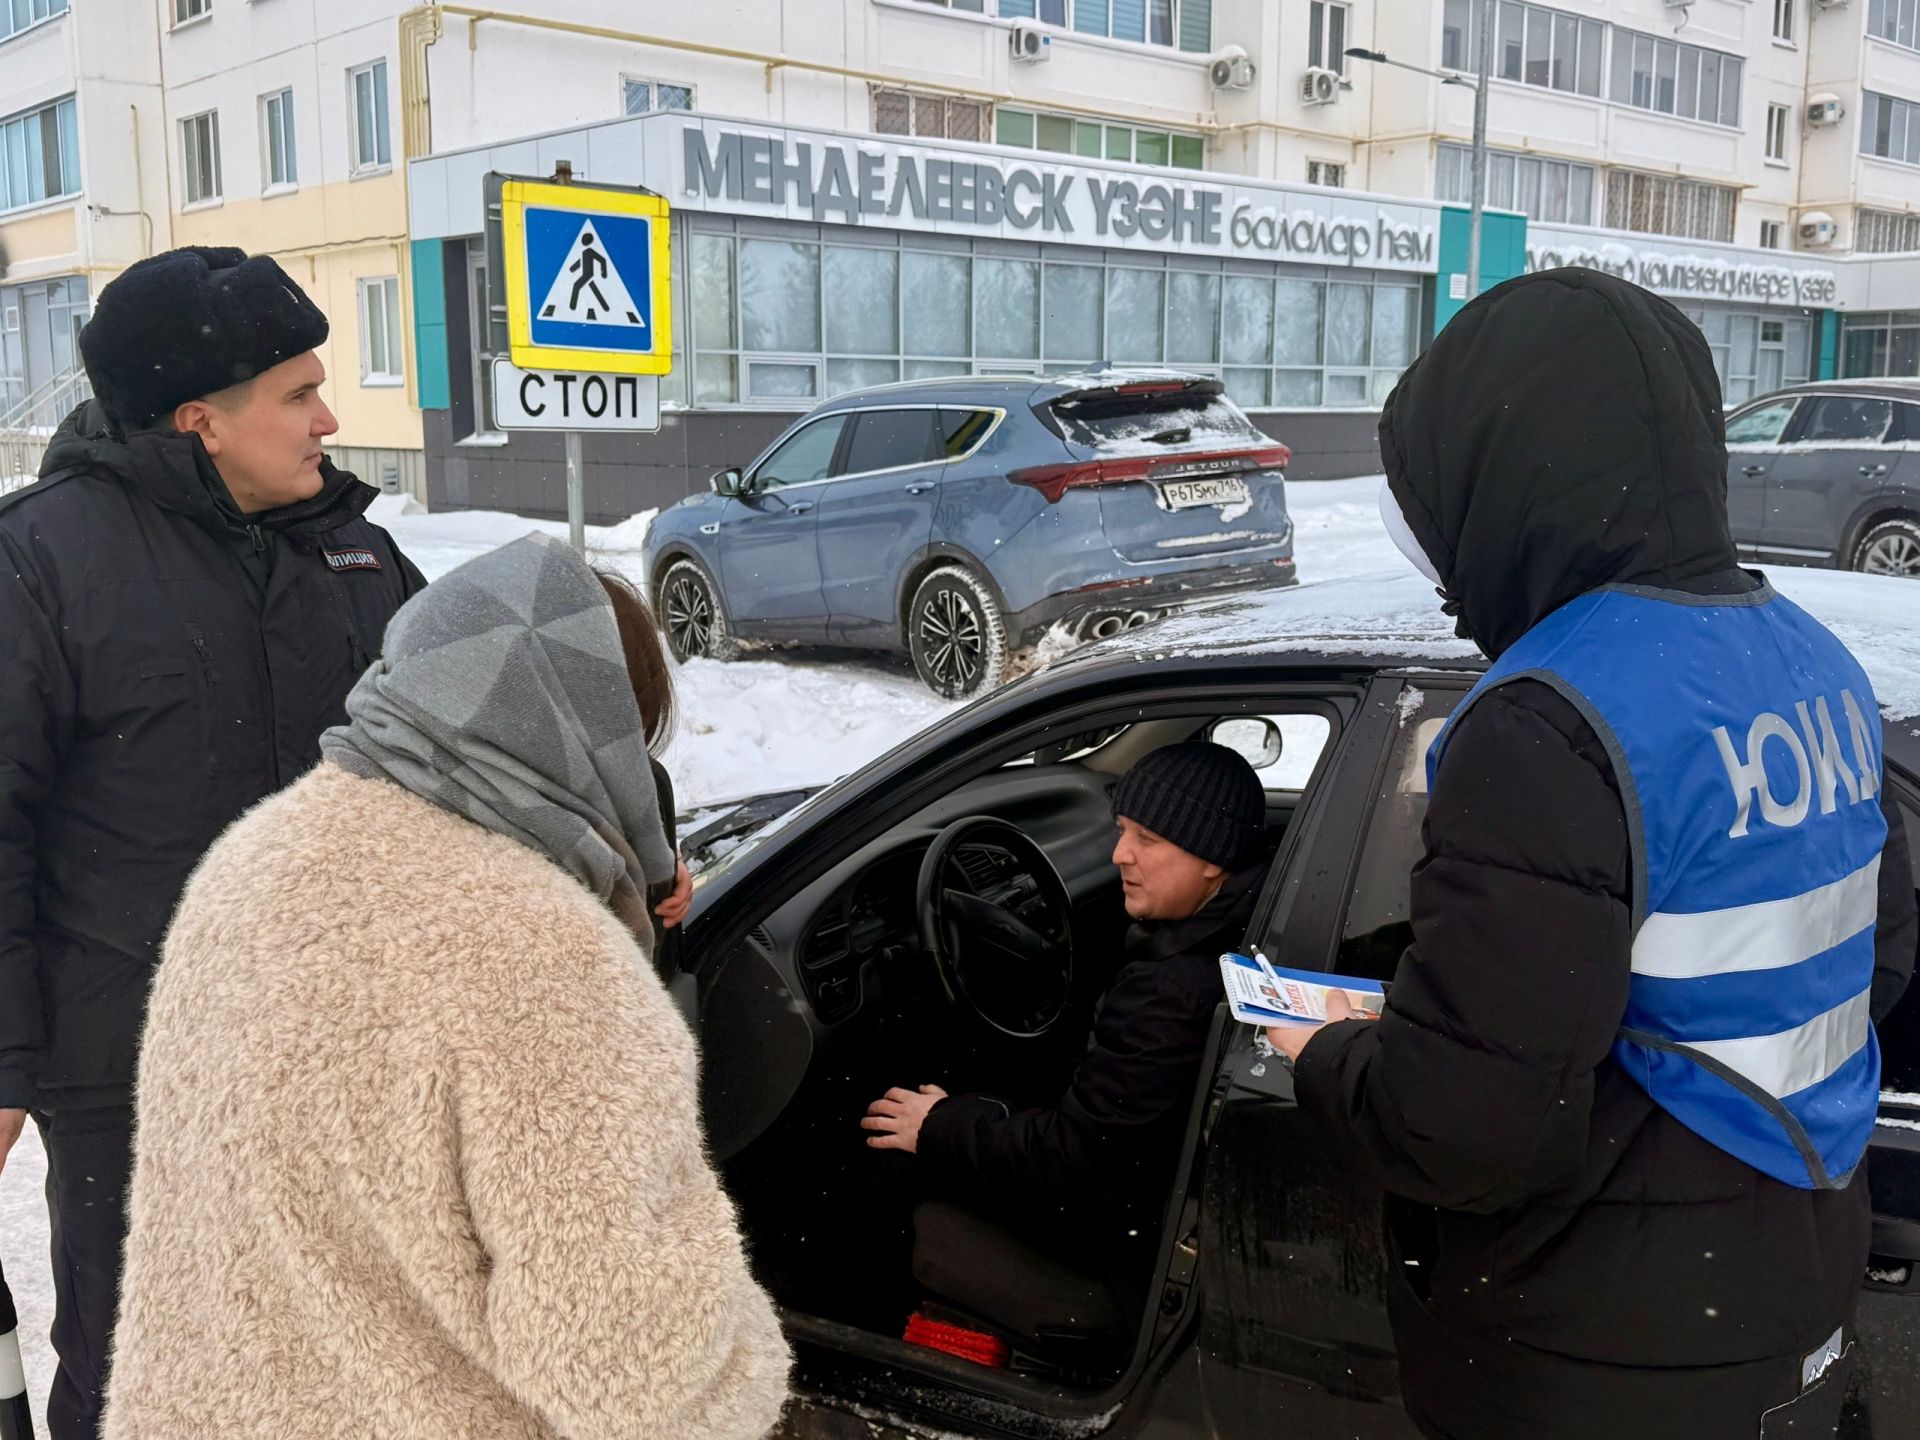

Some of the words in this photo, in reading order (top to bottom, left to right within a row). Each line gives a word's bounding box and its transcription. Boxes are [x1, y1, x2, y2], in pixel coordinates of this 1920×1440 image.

[683, 127, 1075, 231] МЕНДЕЛЕЕВСК
[1230, 203, 1370, 267] балалар
[520, 373, 637, 418] СТОП
[1175, 460, 1240, 472] JETOUR
[326, 552, 377, 567] ОЛИЦИЯ
[1712, 688, 1880, 838] ЮИД
